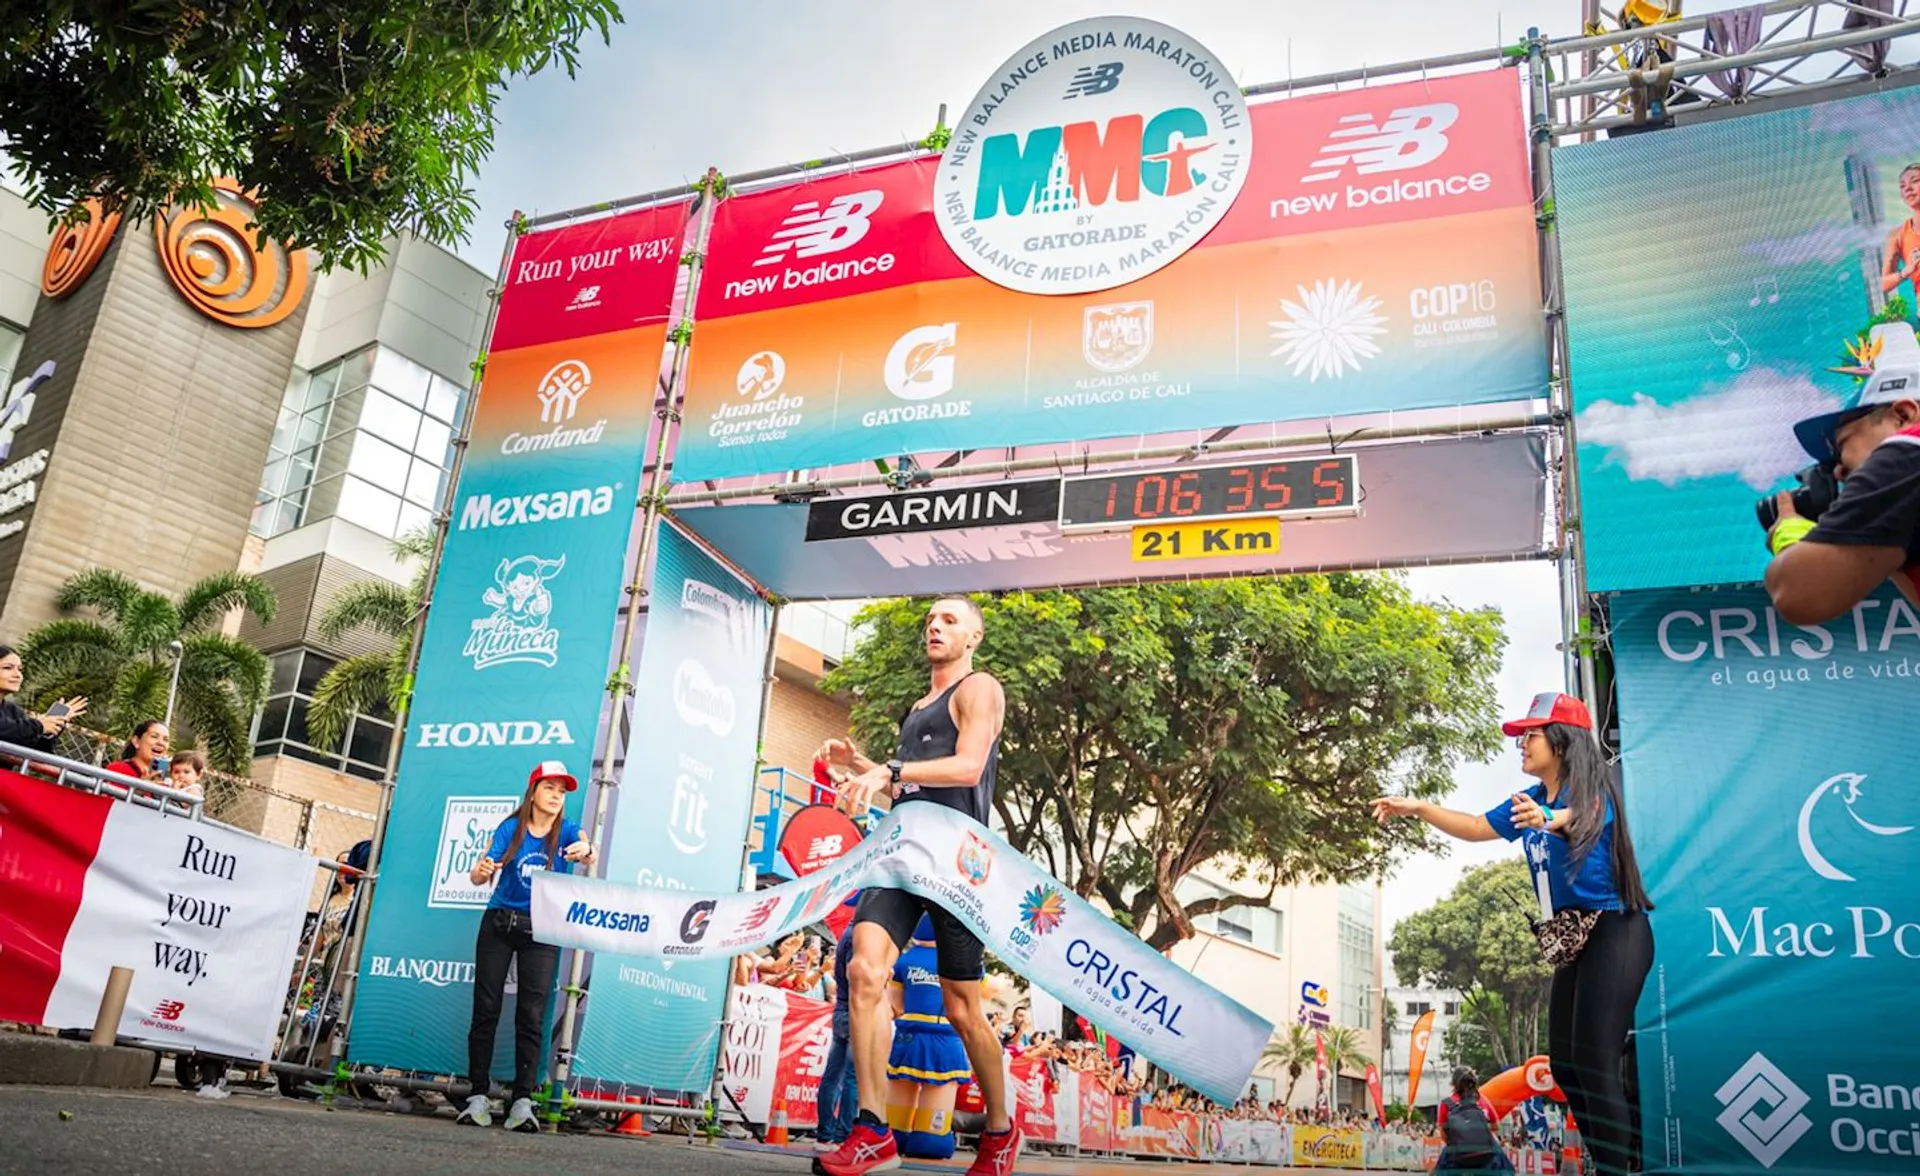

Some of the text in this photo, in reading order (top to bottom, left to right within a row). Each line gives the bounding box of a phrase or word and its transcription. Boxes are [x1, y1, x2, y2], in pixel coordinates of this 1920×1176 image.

[952, 31, 1241, 167] NEW BALANCE MEDIA MARATÓN CALI
[1270, 171, 1491, 218] new balance
[944, 152, 1241, 283] NEW BALANCE MEDIA MARATÓN CALI
[1076, 214, 1095, 226] BY
[1023, 224, 1147, 253] GATORADE
[515, 237, 675, 285] Run your way.
[724, 252, 896, 299] new balance
[1409, 278, 1497, 319] COP16
[1413, 315, 1497, 336] CALI COLOMBIA
[1142, 371, 1161, 383] DE
[711, 392, 804, 420] Juancho
[1043, 382, 1192, 409] SANTIAGO DE CALI
[708, 410, 803, 438] Correlón
[862, 400, 972, 428] GATORADE
[501, 419, 607, 454] Comfandi
[1226, 465, 1291, 512] 35
[1312, 462, 1344, 507] 5
[458, 485, 614, 531] Mexsana
[1141, 531, 1181, 557] 21
[1202, 528, 1272, 553] Km
[1711, 666, 1732, 685] el
[1746, 666, 1811, 689] agua
[1825, 661, 1855, 681] de
[416, 720, 575, 747] HONDA
[453, 806, 508, 814] FARMACIA
[179, 834, 237, 881] Run
[441, 839, 482, 885] Jor
[913, 875, 966, 909] SANTIAGO
[160, 892, 231, 929] your
[566, 901, 650, 934] Mexsana
[1705, 906, 1836, 957] Mac
[153, 941, 208, 987] way.
[369, 955, 476, 987] BLANQUIT
[1066, 939, 1183, 1036] CRISTAL
[1073, 978, 1155, 1035] el agua de vida
